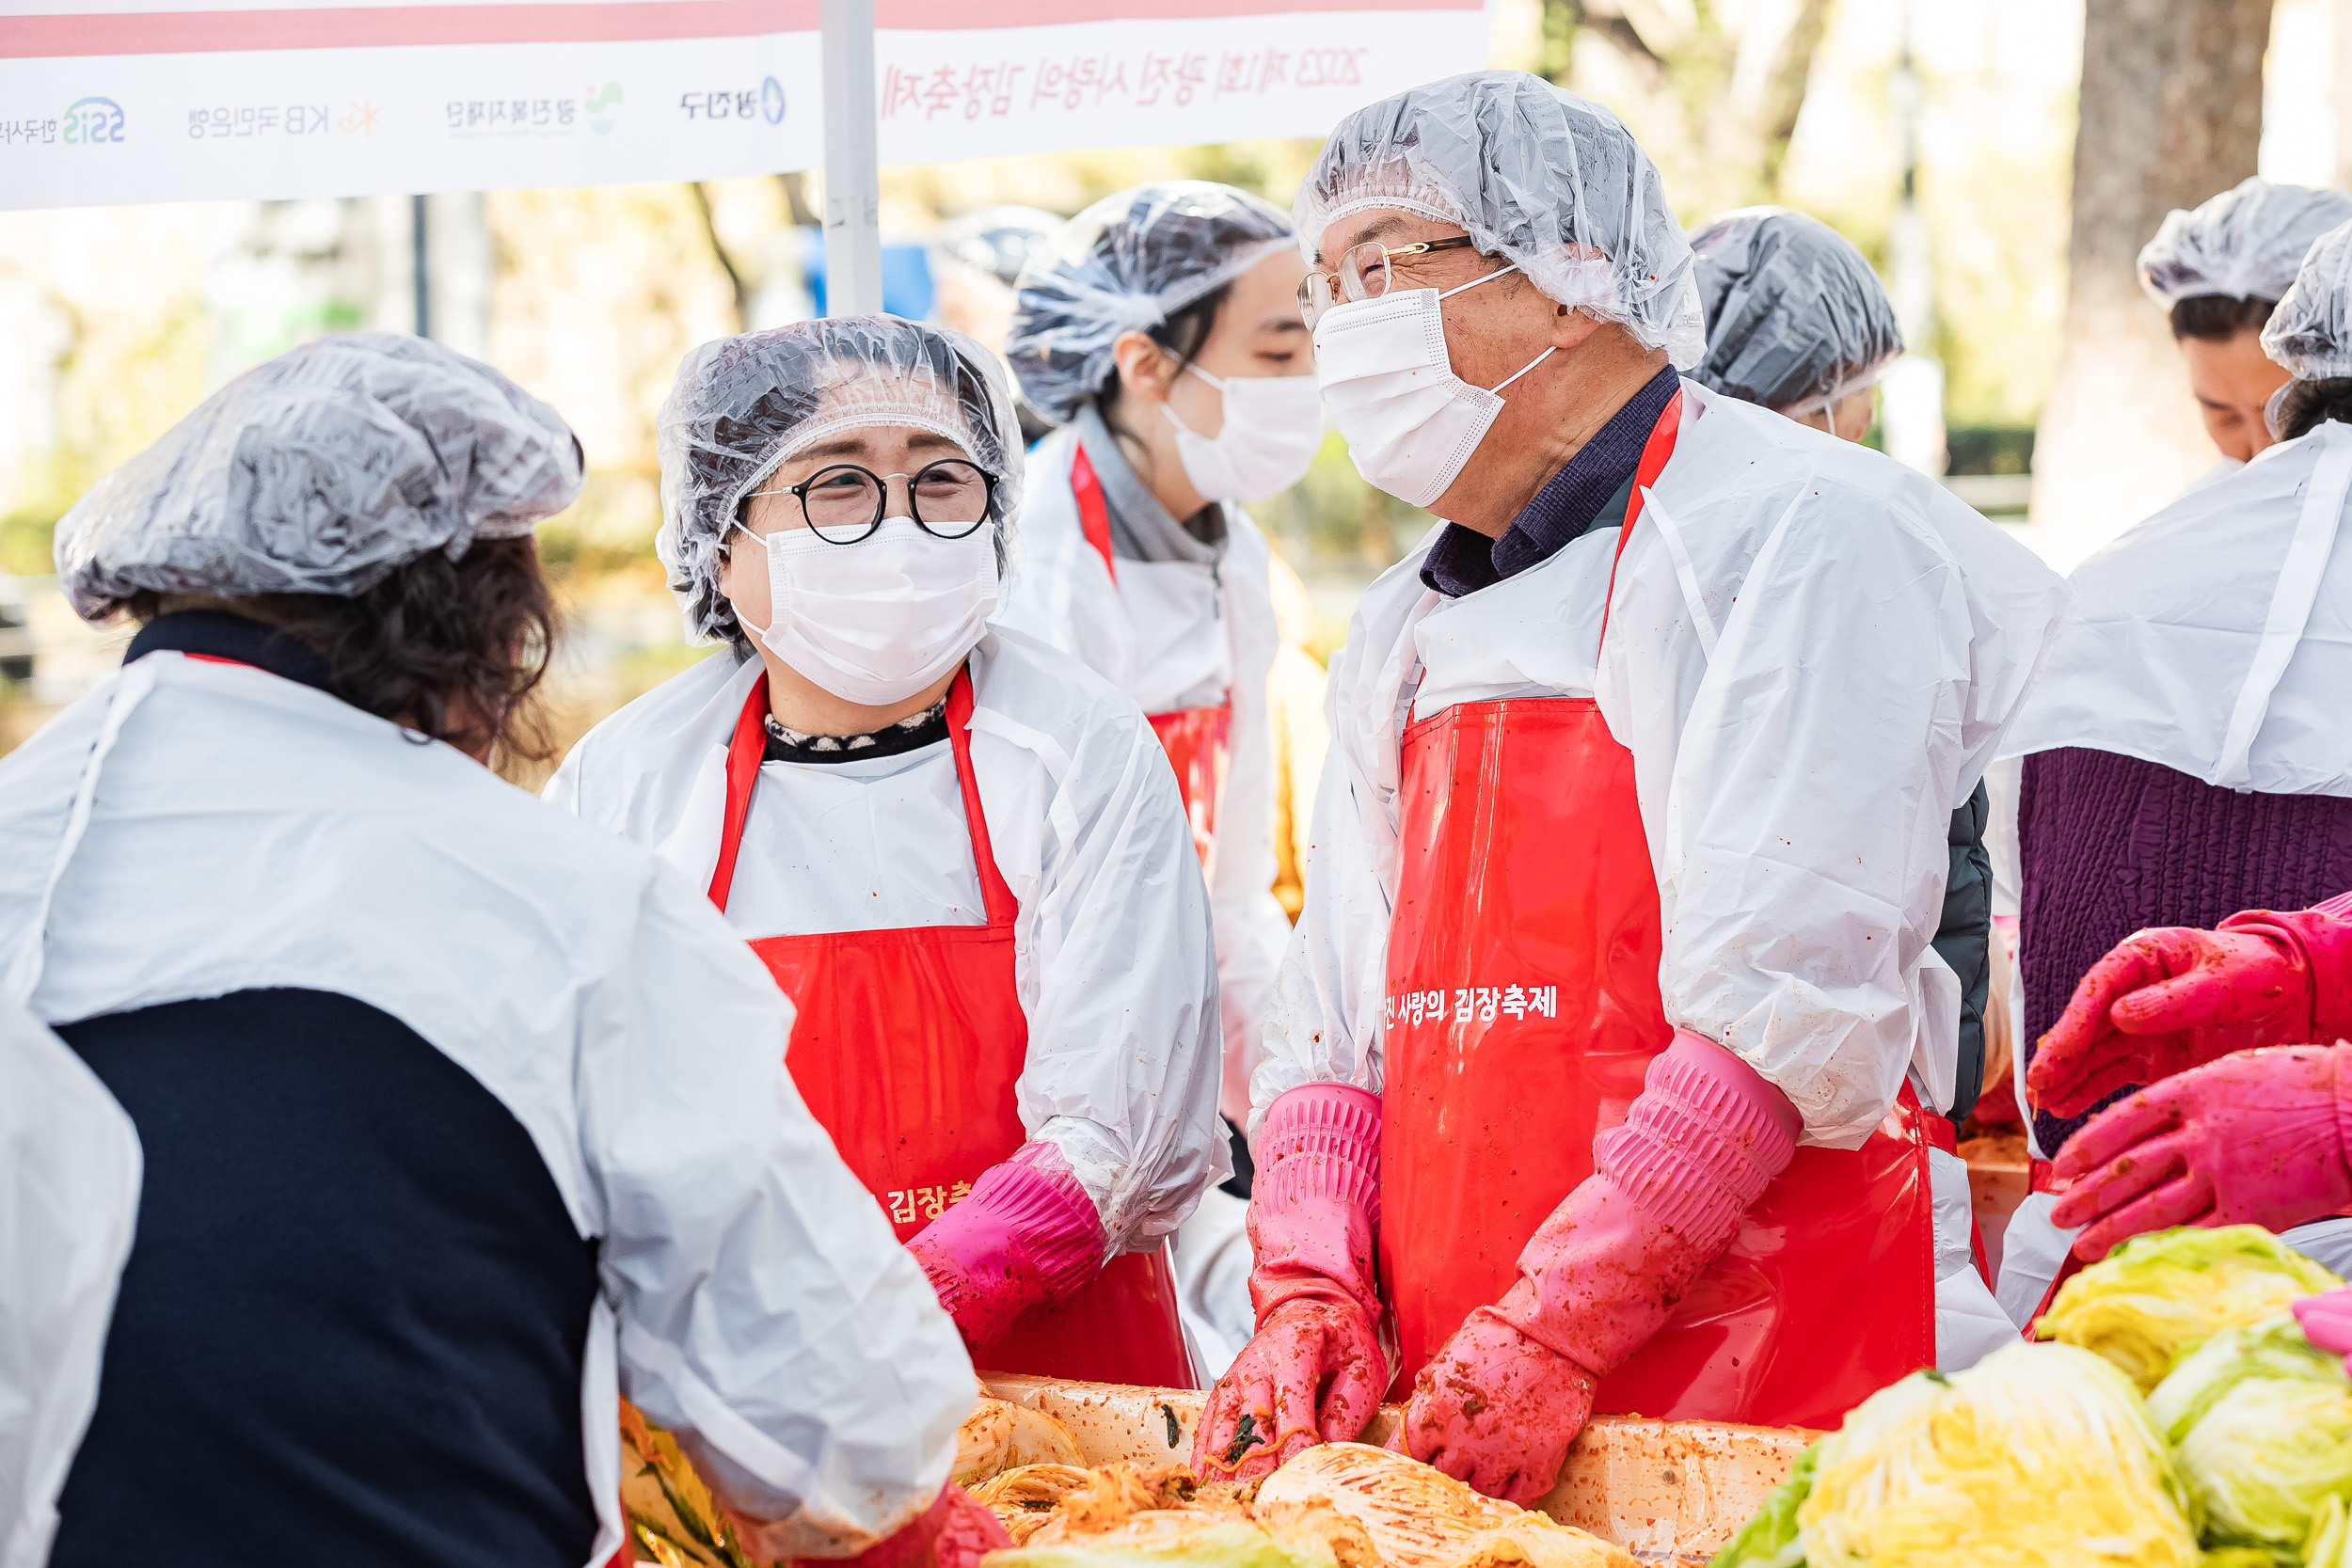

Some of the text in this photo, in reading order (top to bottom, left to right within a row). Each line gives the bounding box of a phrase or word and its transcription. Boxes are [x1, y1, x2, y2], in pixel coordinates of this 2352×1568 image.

[1385, 983, 1557, 1030] 진 사랑의 김장축제
